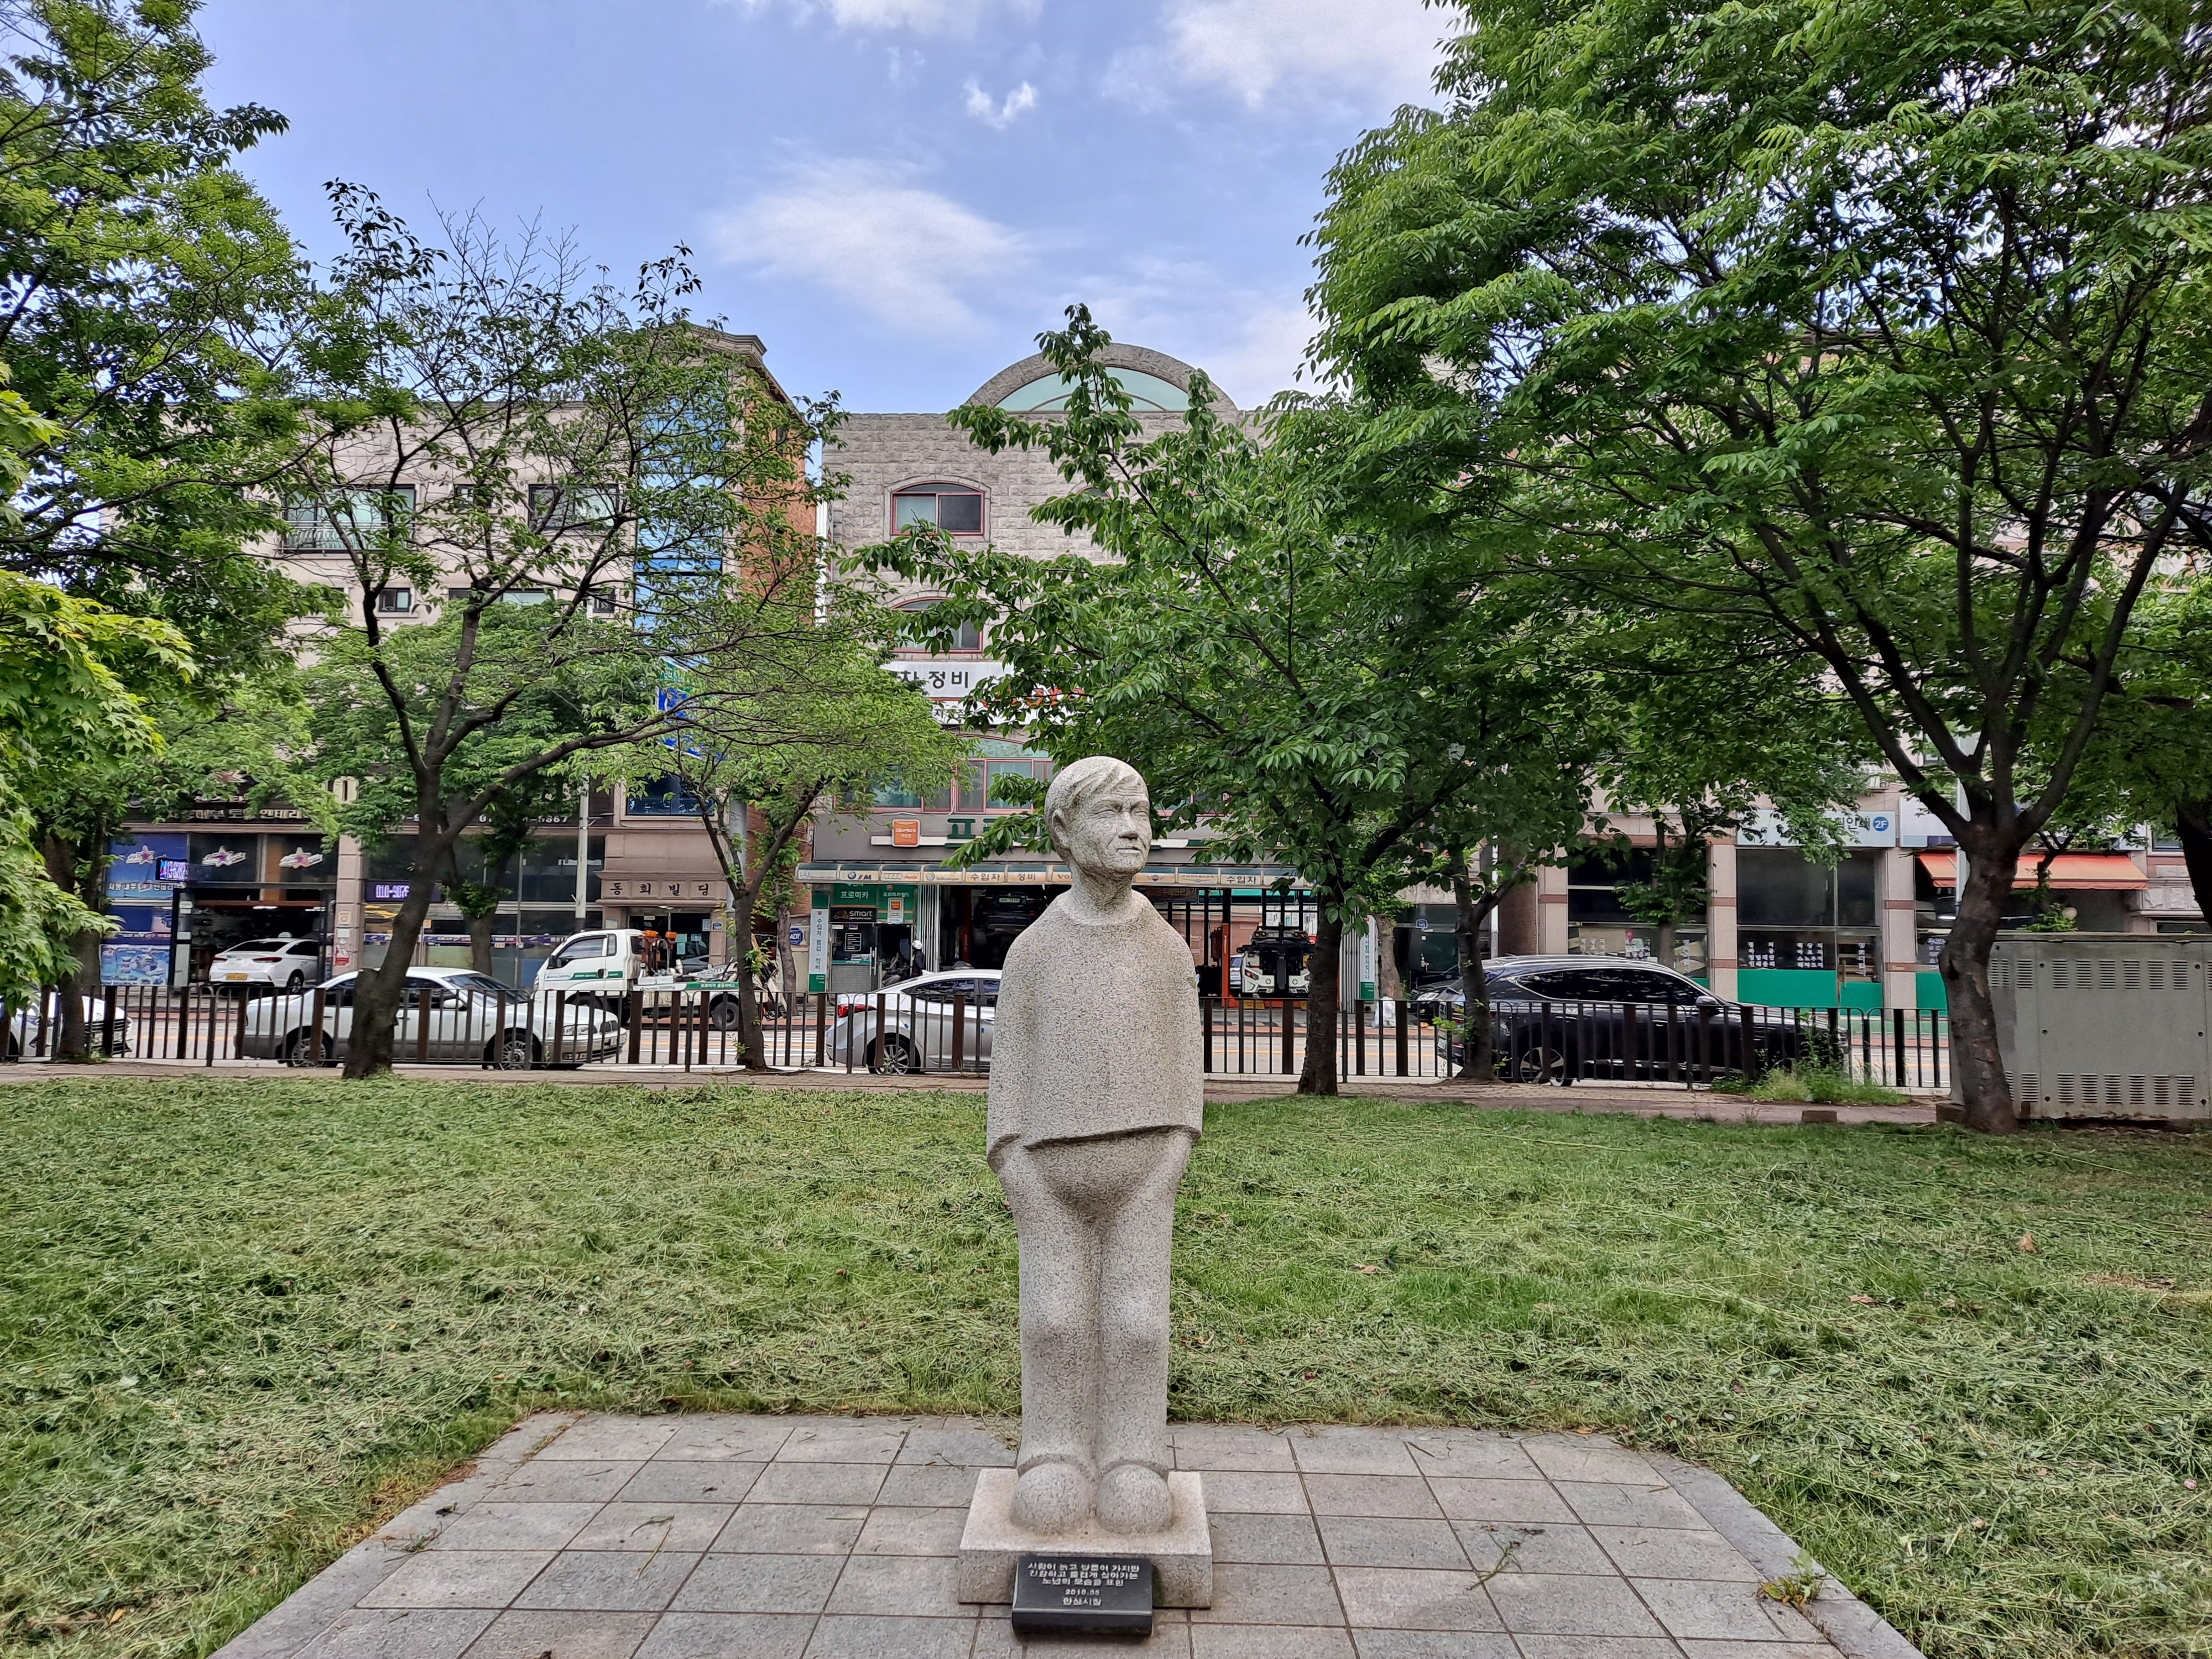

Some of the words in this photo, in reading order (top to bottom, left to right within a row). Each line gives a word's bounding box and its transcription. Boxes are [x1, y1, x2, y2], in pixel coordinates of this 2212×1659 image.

[1875, 820, 1887, 829] 2F
[1017, 873, 1036, 881] 정비
[1112, 1564, 1140, 1572] 가지만
